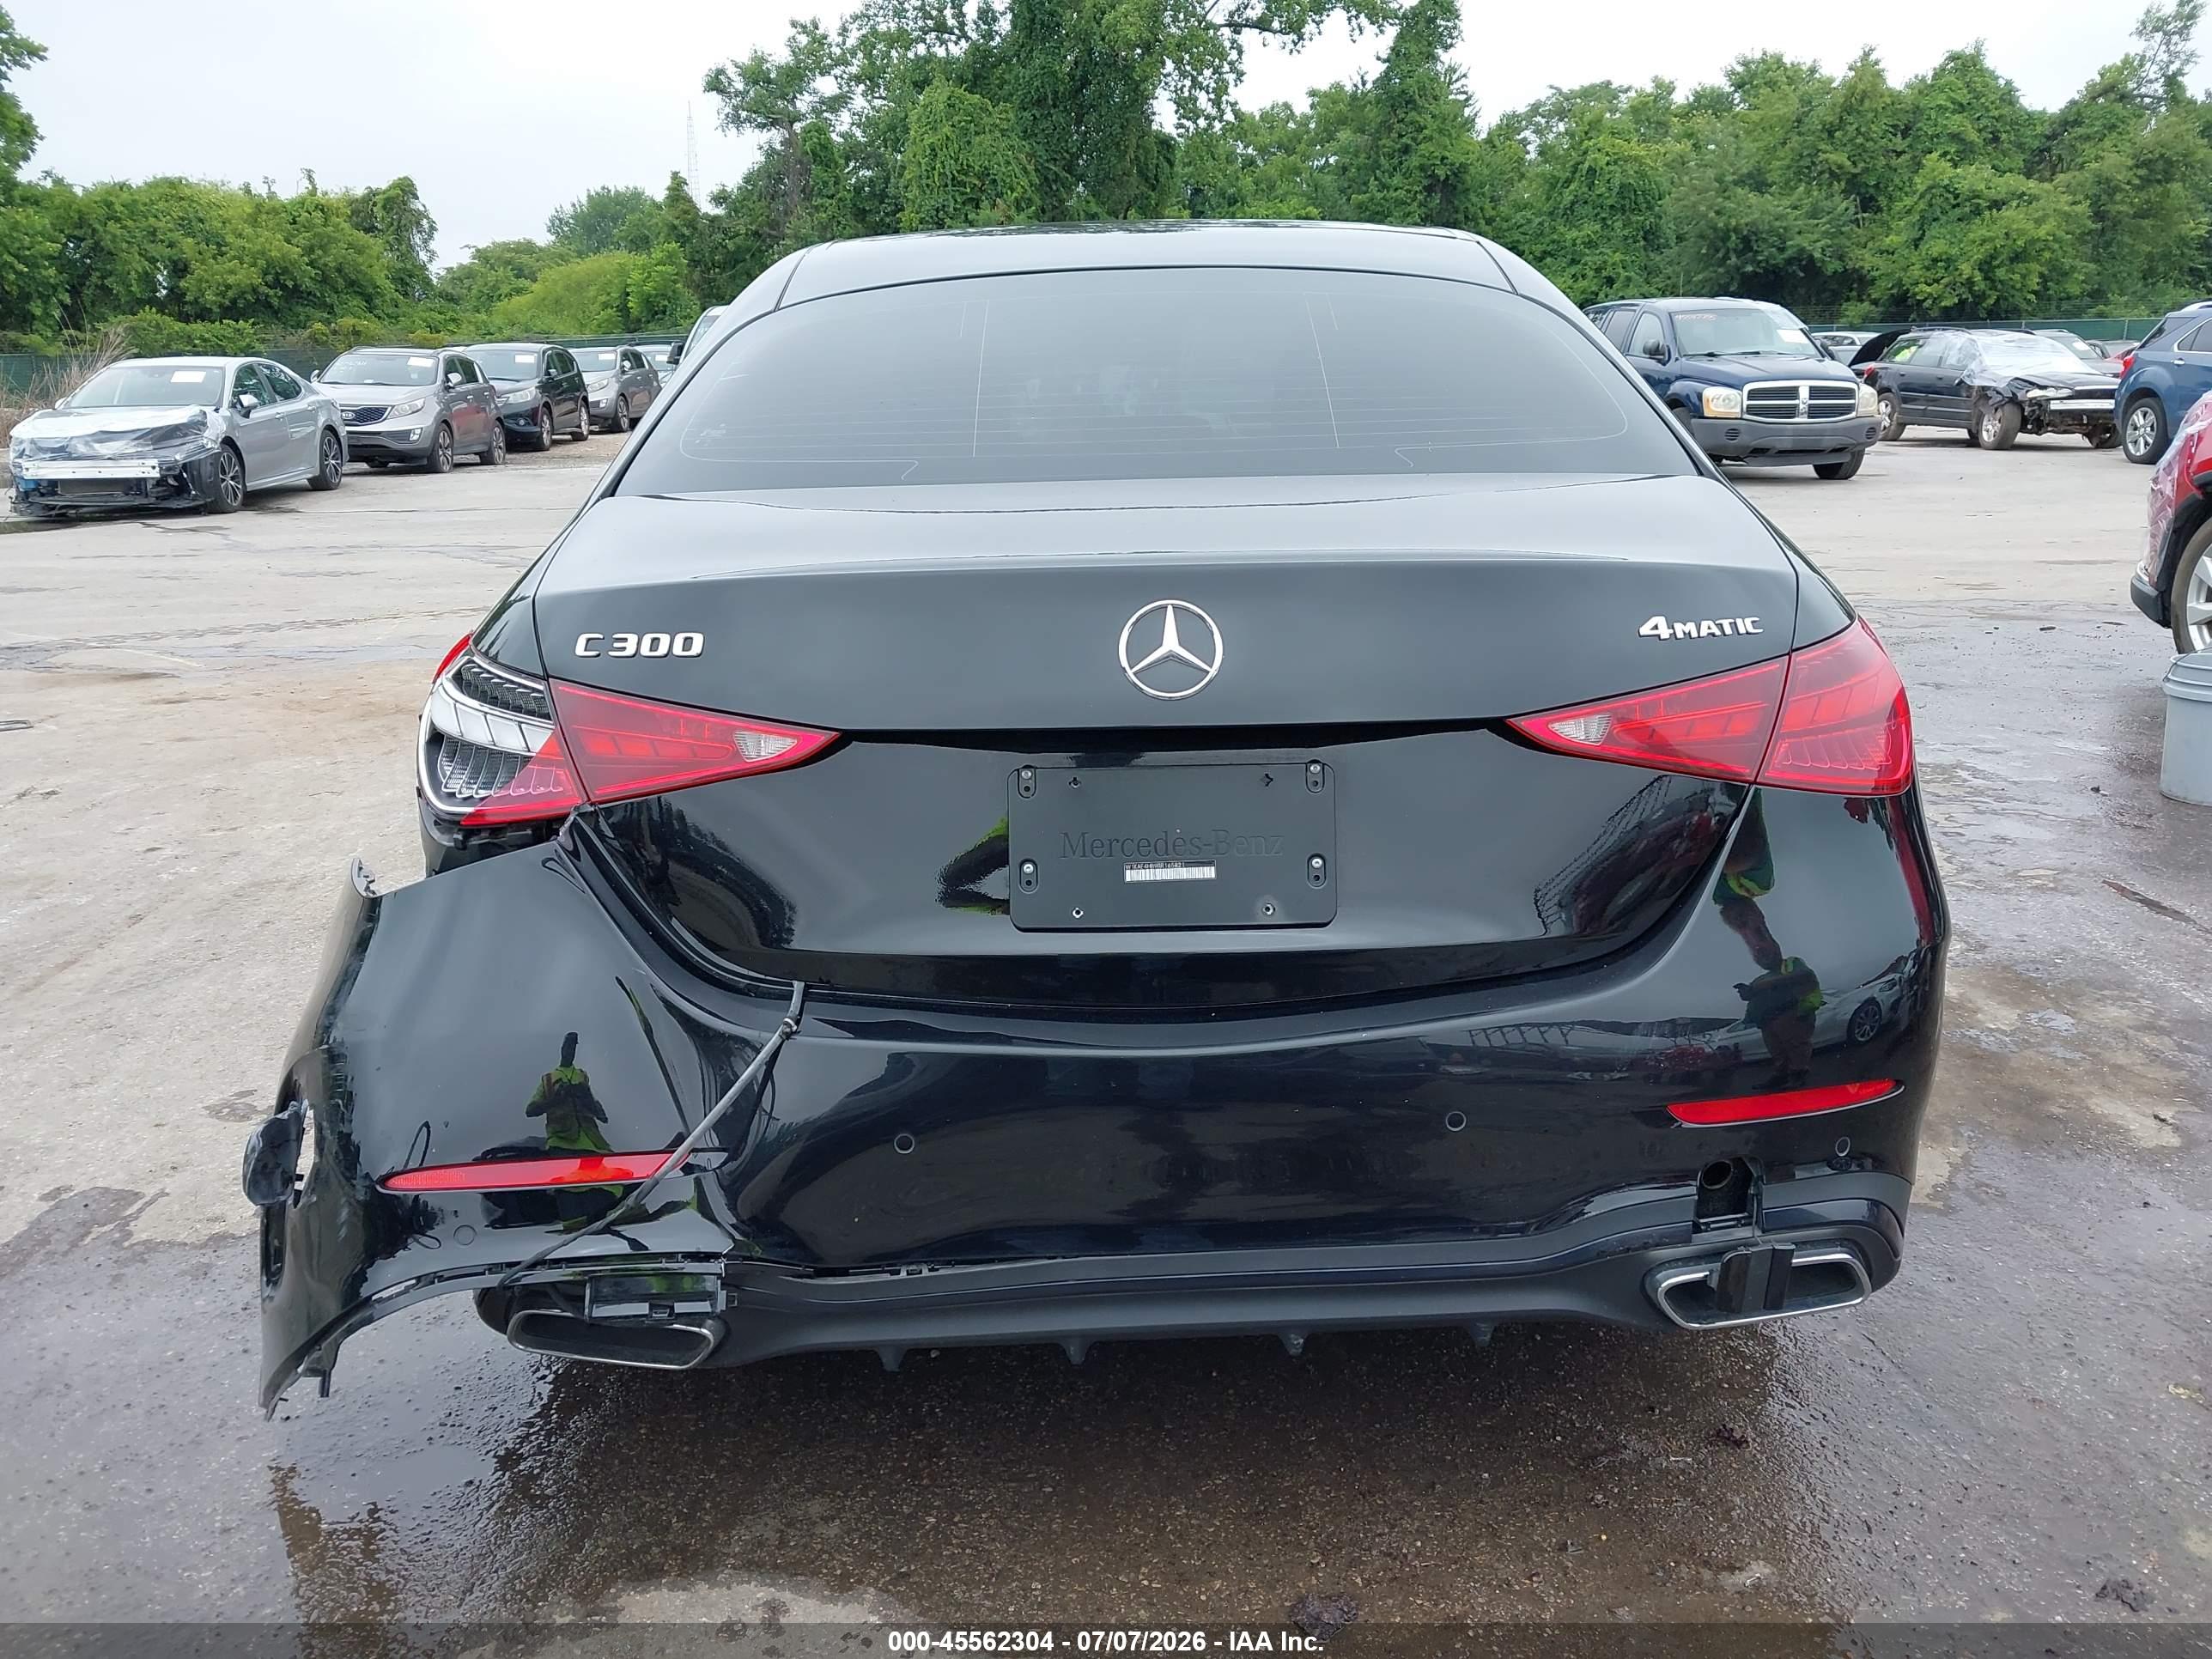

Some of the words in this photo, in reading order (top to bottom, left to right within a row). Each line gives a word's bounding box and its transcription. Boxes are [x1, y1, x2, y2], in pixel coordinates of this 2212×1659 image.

[1638, 615, 1764, 641] 4MATIC
[574, 632, 605, 658] C
[607, 632, 705, 659] 300
[1059, 828, 1285, 859] Mercedes-Benz
